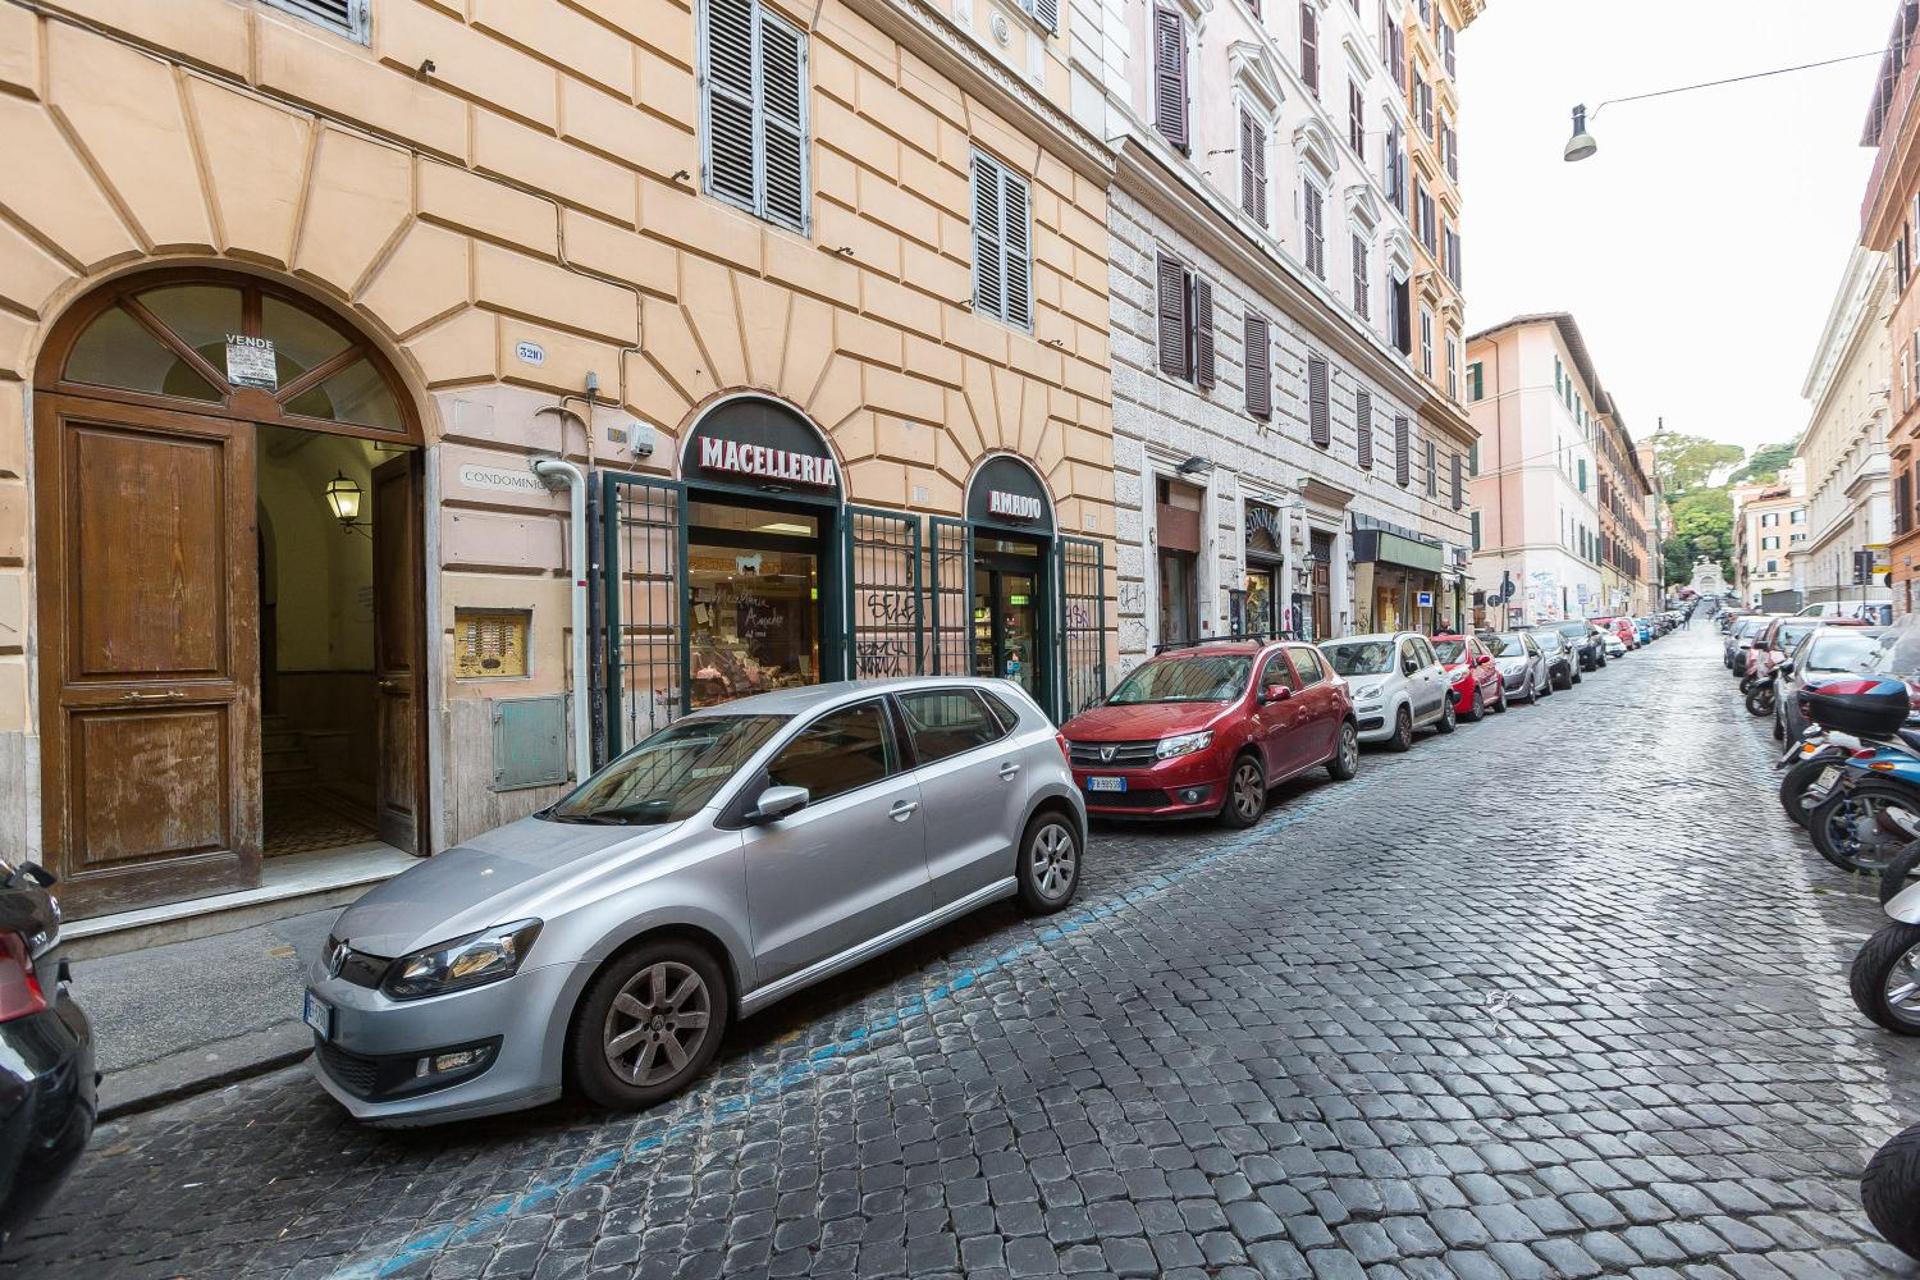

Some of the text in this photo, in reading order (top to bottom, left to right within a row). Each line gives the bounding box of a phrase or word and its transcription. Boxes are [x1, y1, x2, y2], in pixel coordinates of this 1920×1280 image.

[225, 334, 273, 350] VENDE
[698, 435, 837, 485] MACELLERIA
[988, 490, 1041, 519] AMADIO
